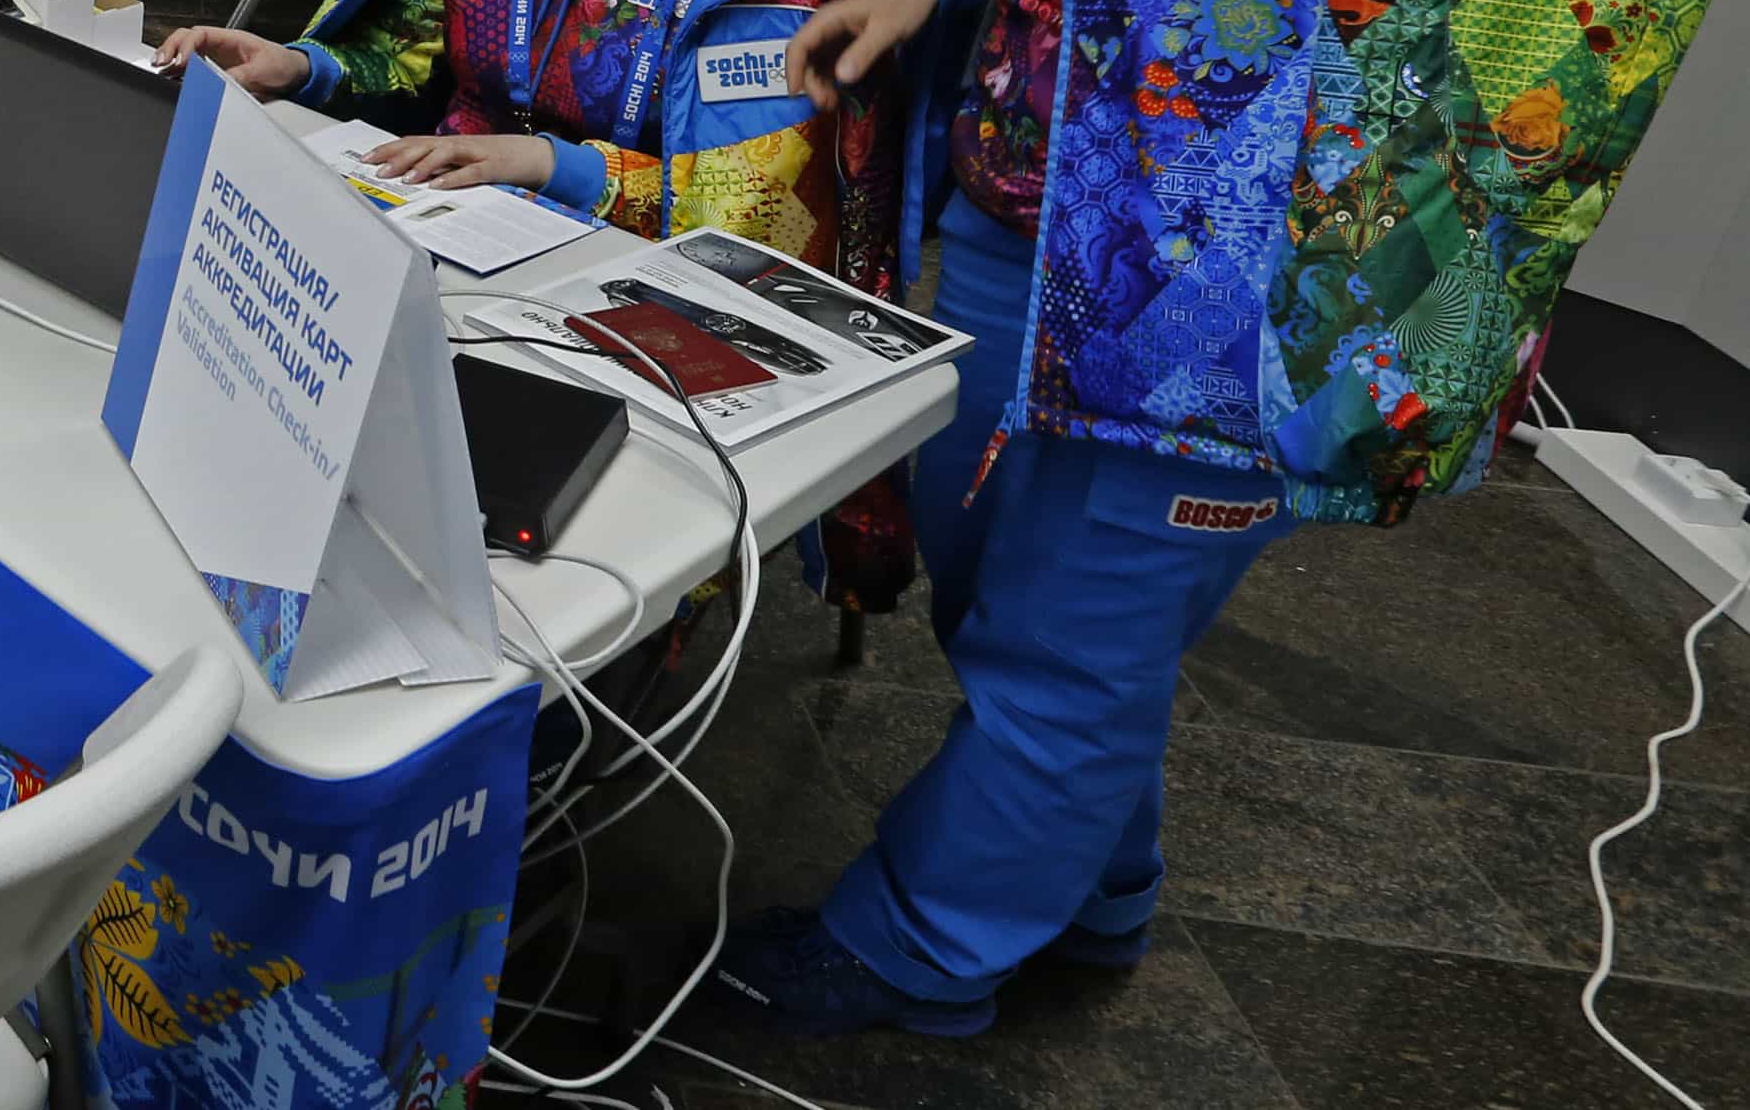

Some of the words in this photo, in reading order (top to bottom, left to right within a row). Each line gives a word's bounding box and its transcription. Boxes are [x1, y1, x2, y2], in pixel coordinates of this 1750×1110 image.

[514, 17, 527, 46] 2014
[706, 52, 784, 74] sochi.r
[623, 85, 644, 122] SOCHI
[634, 52, 654, 83] 2014
[720, 70, 768, 88] 2014
[211, 170, 340, 312] РЕГИСТРАЦИЯ/
[192, 243, 325, 407] АККРЕДИТАЦИИ
[201, 207, 300, 328] АКТИВАЦИЯ
[302, 314, 353, 381] КАРТ
[177, 310, 237, 402] Validation
[182, 285, 265, 397] Accreditation
[267, 386, 340, 481] Check-in/
[1172, 498, 1256, 529] BOSCO
[370, 788, 488, 899] 2014
